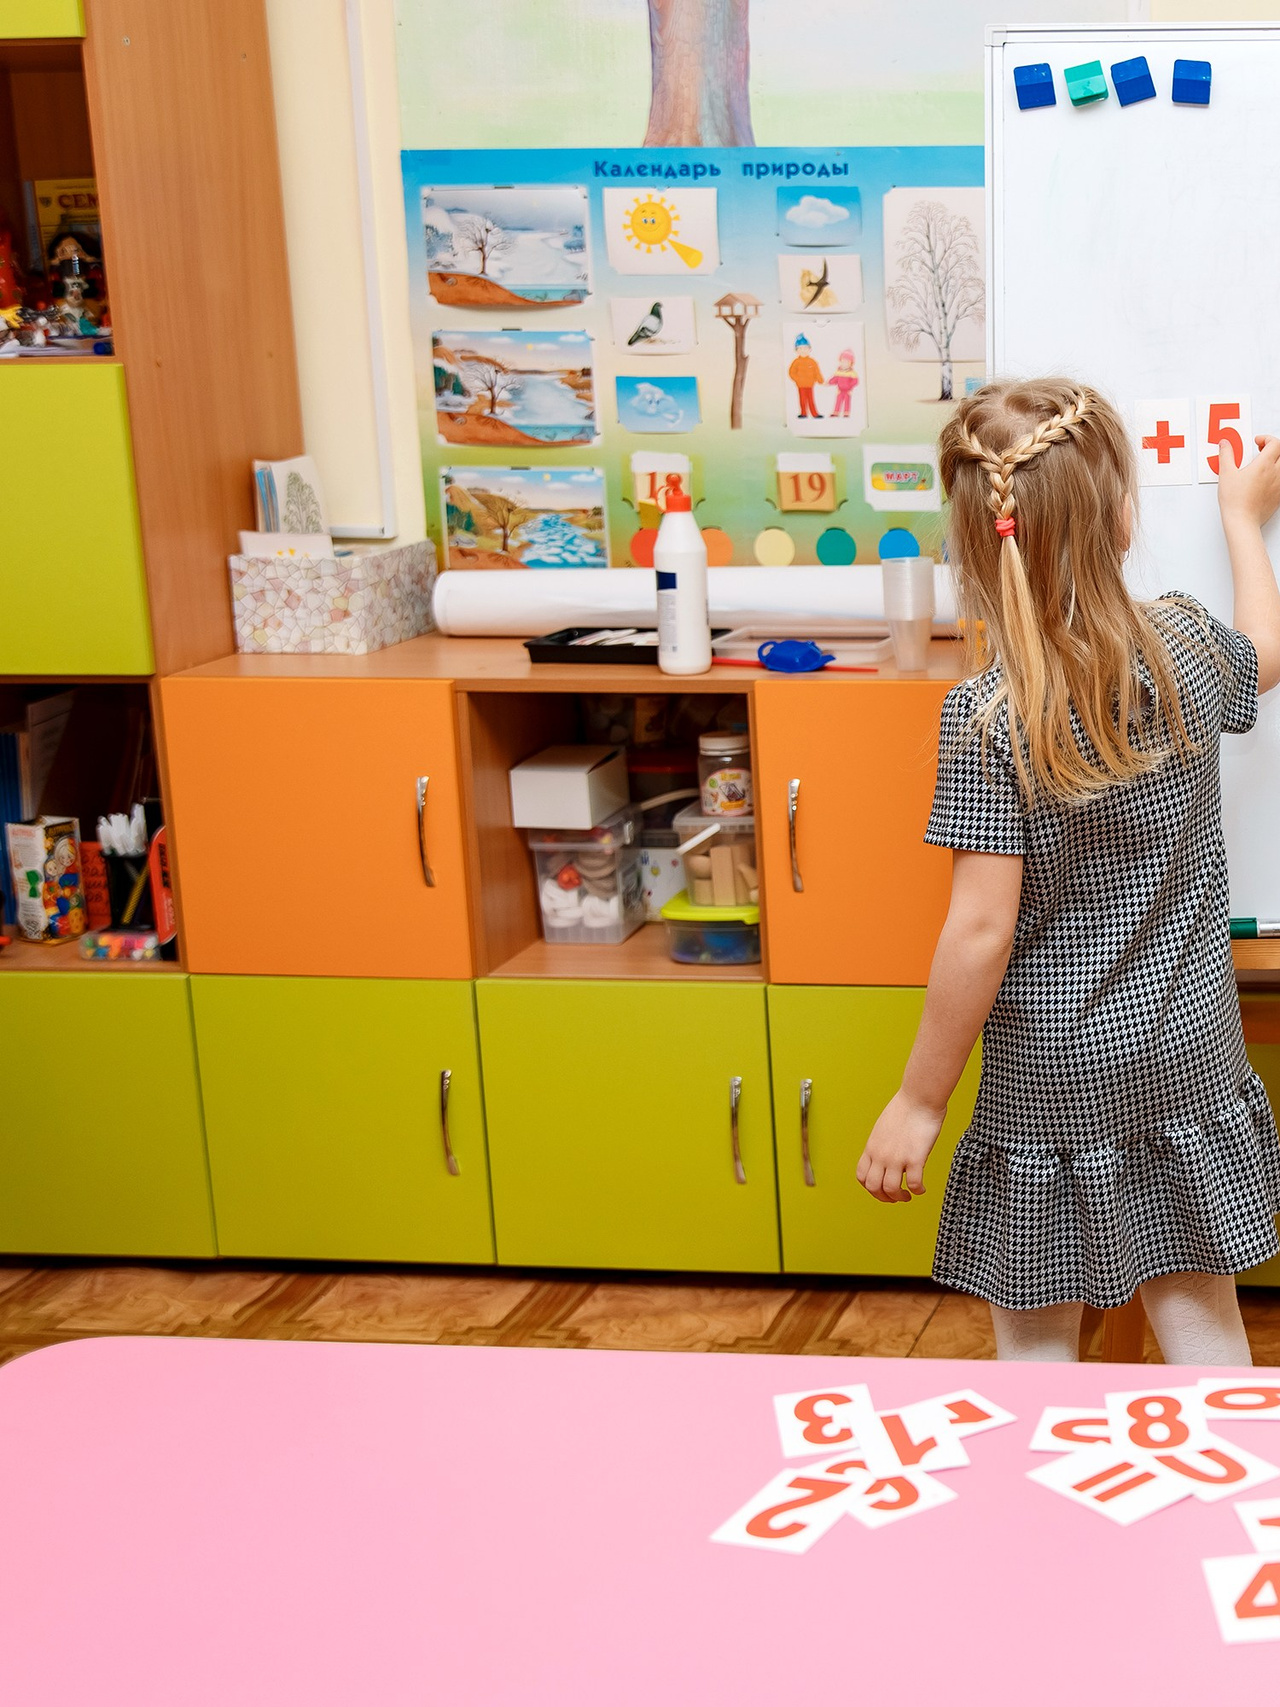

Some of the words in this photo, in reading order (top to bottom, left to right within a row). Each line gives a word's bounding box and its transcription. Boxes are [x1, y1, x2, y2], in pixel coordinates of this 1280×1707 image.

[593, 160, 722, 180] Календарь
[741, 161, 850, 180] природы
[1206, 403, 1244, 476] 5
[789, 472, 827, 504] 19
[883, 471, 920, 482] МАРТ
[794, 1393, 853, 1444] 3
[1127, 1395, 1190, 1449] 8
[745, 1476, 851, 1539] 2
